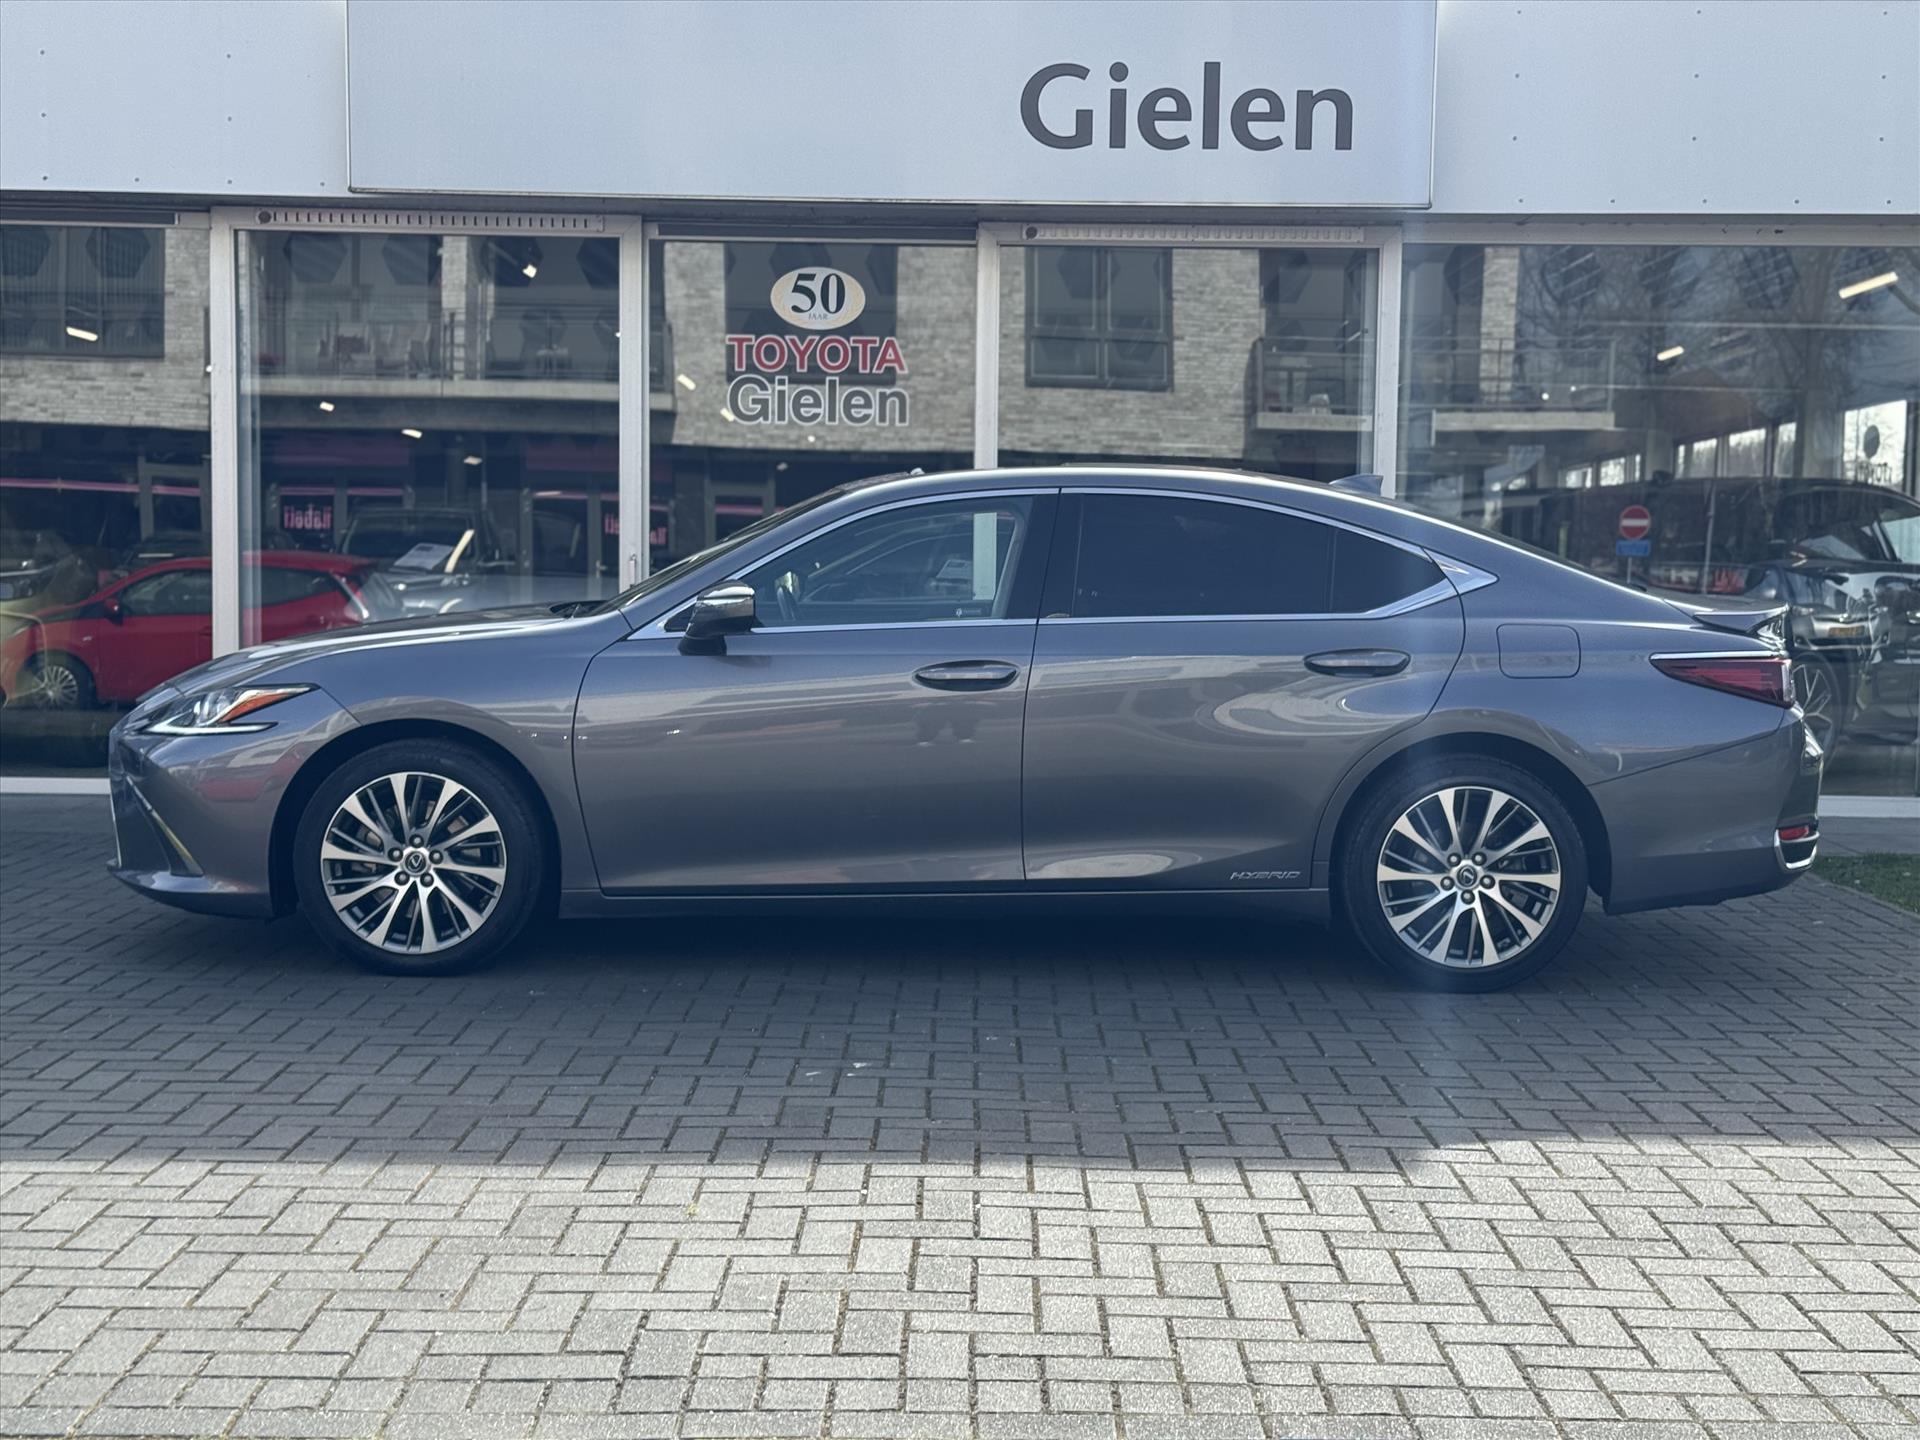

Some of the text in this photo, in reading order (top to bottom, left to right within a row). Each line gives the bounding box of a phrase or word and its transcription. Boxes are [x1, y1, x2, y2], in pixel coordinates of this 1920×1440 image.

[1020, 61, 1353, 152] Gielen
[790, 273, 846, 314] 50
[726, 334, 909, 374] TOYOTA
[728, 374, 909, 427] Gielen
[1230, 871, 1301, 880] HYBRID
